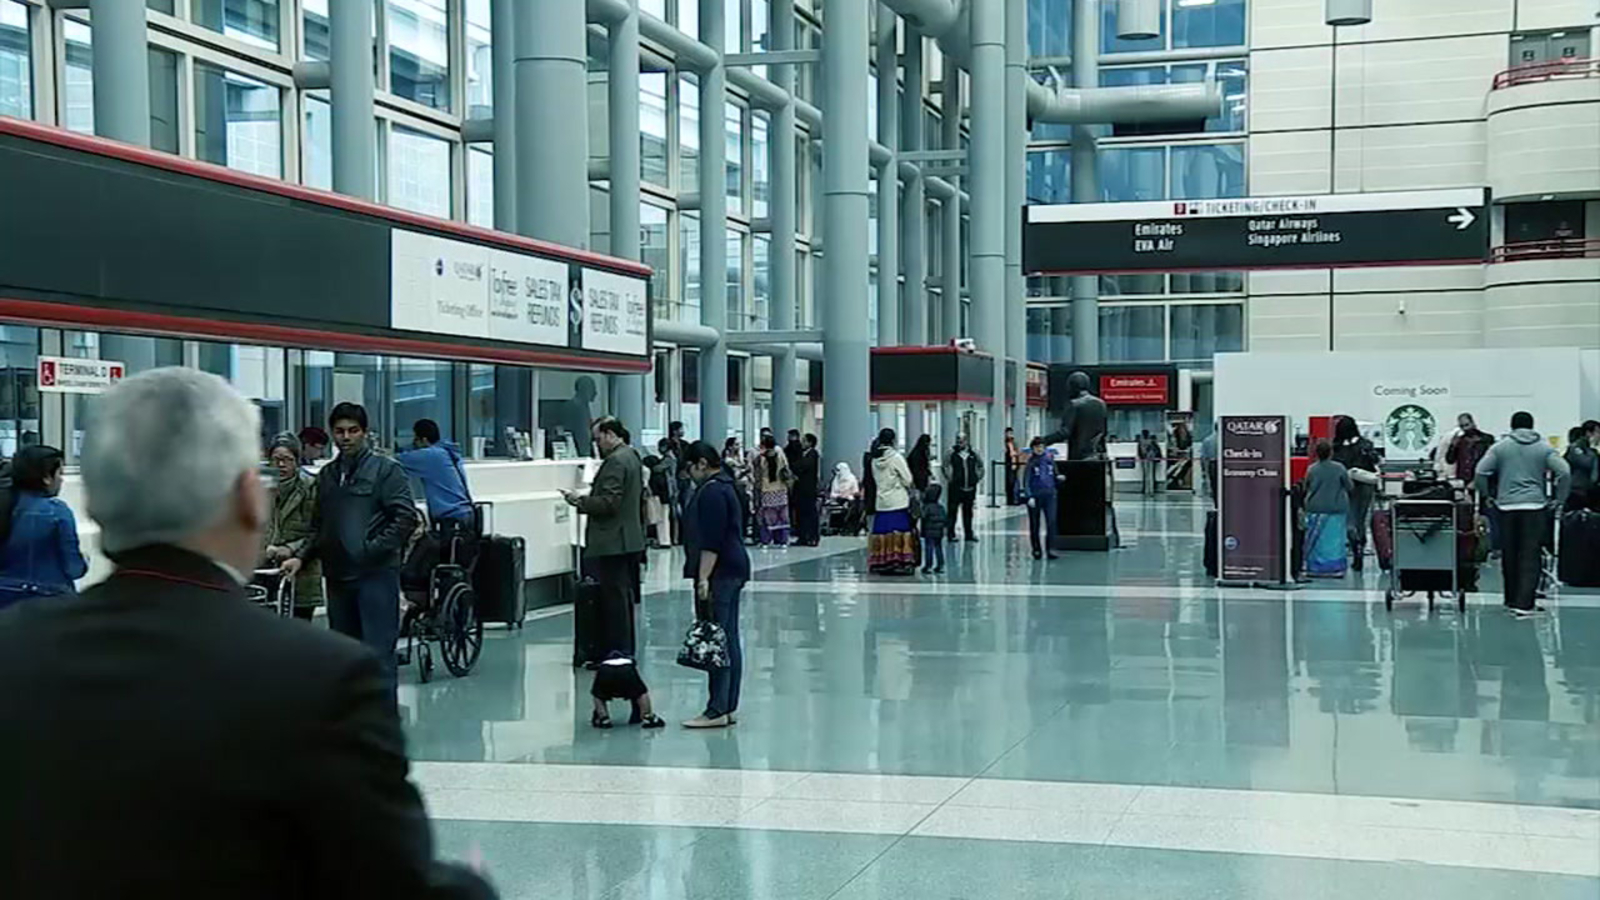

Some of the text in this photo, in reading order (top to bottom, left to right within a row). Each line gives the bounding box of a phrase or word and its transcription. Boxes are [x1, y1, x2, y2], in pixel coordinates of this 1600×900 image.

[1206, 199, 1317, 214] TICKETING/CHECK-IN
[1135, 222, 1183, 236] Emirates
[1248, 217, 1318, 231] Qatar Airways
[1135, 238, 1174, 252] EVA Air
[1248, 230, 1341, 247] Singapore Airlines
[526, 275, 548, 300] SALES
[527, 302, 561, 327] REFUNDS
[59, 362, 100, 377] TERMINAL
[1373, 384, 1448, 398] Coming Soon
[1226, 420, 1263, 432] QATAR
[1224, 448, 1263, 458] Check-in
